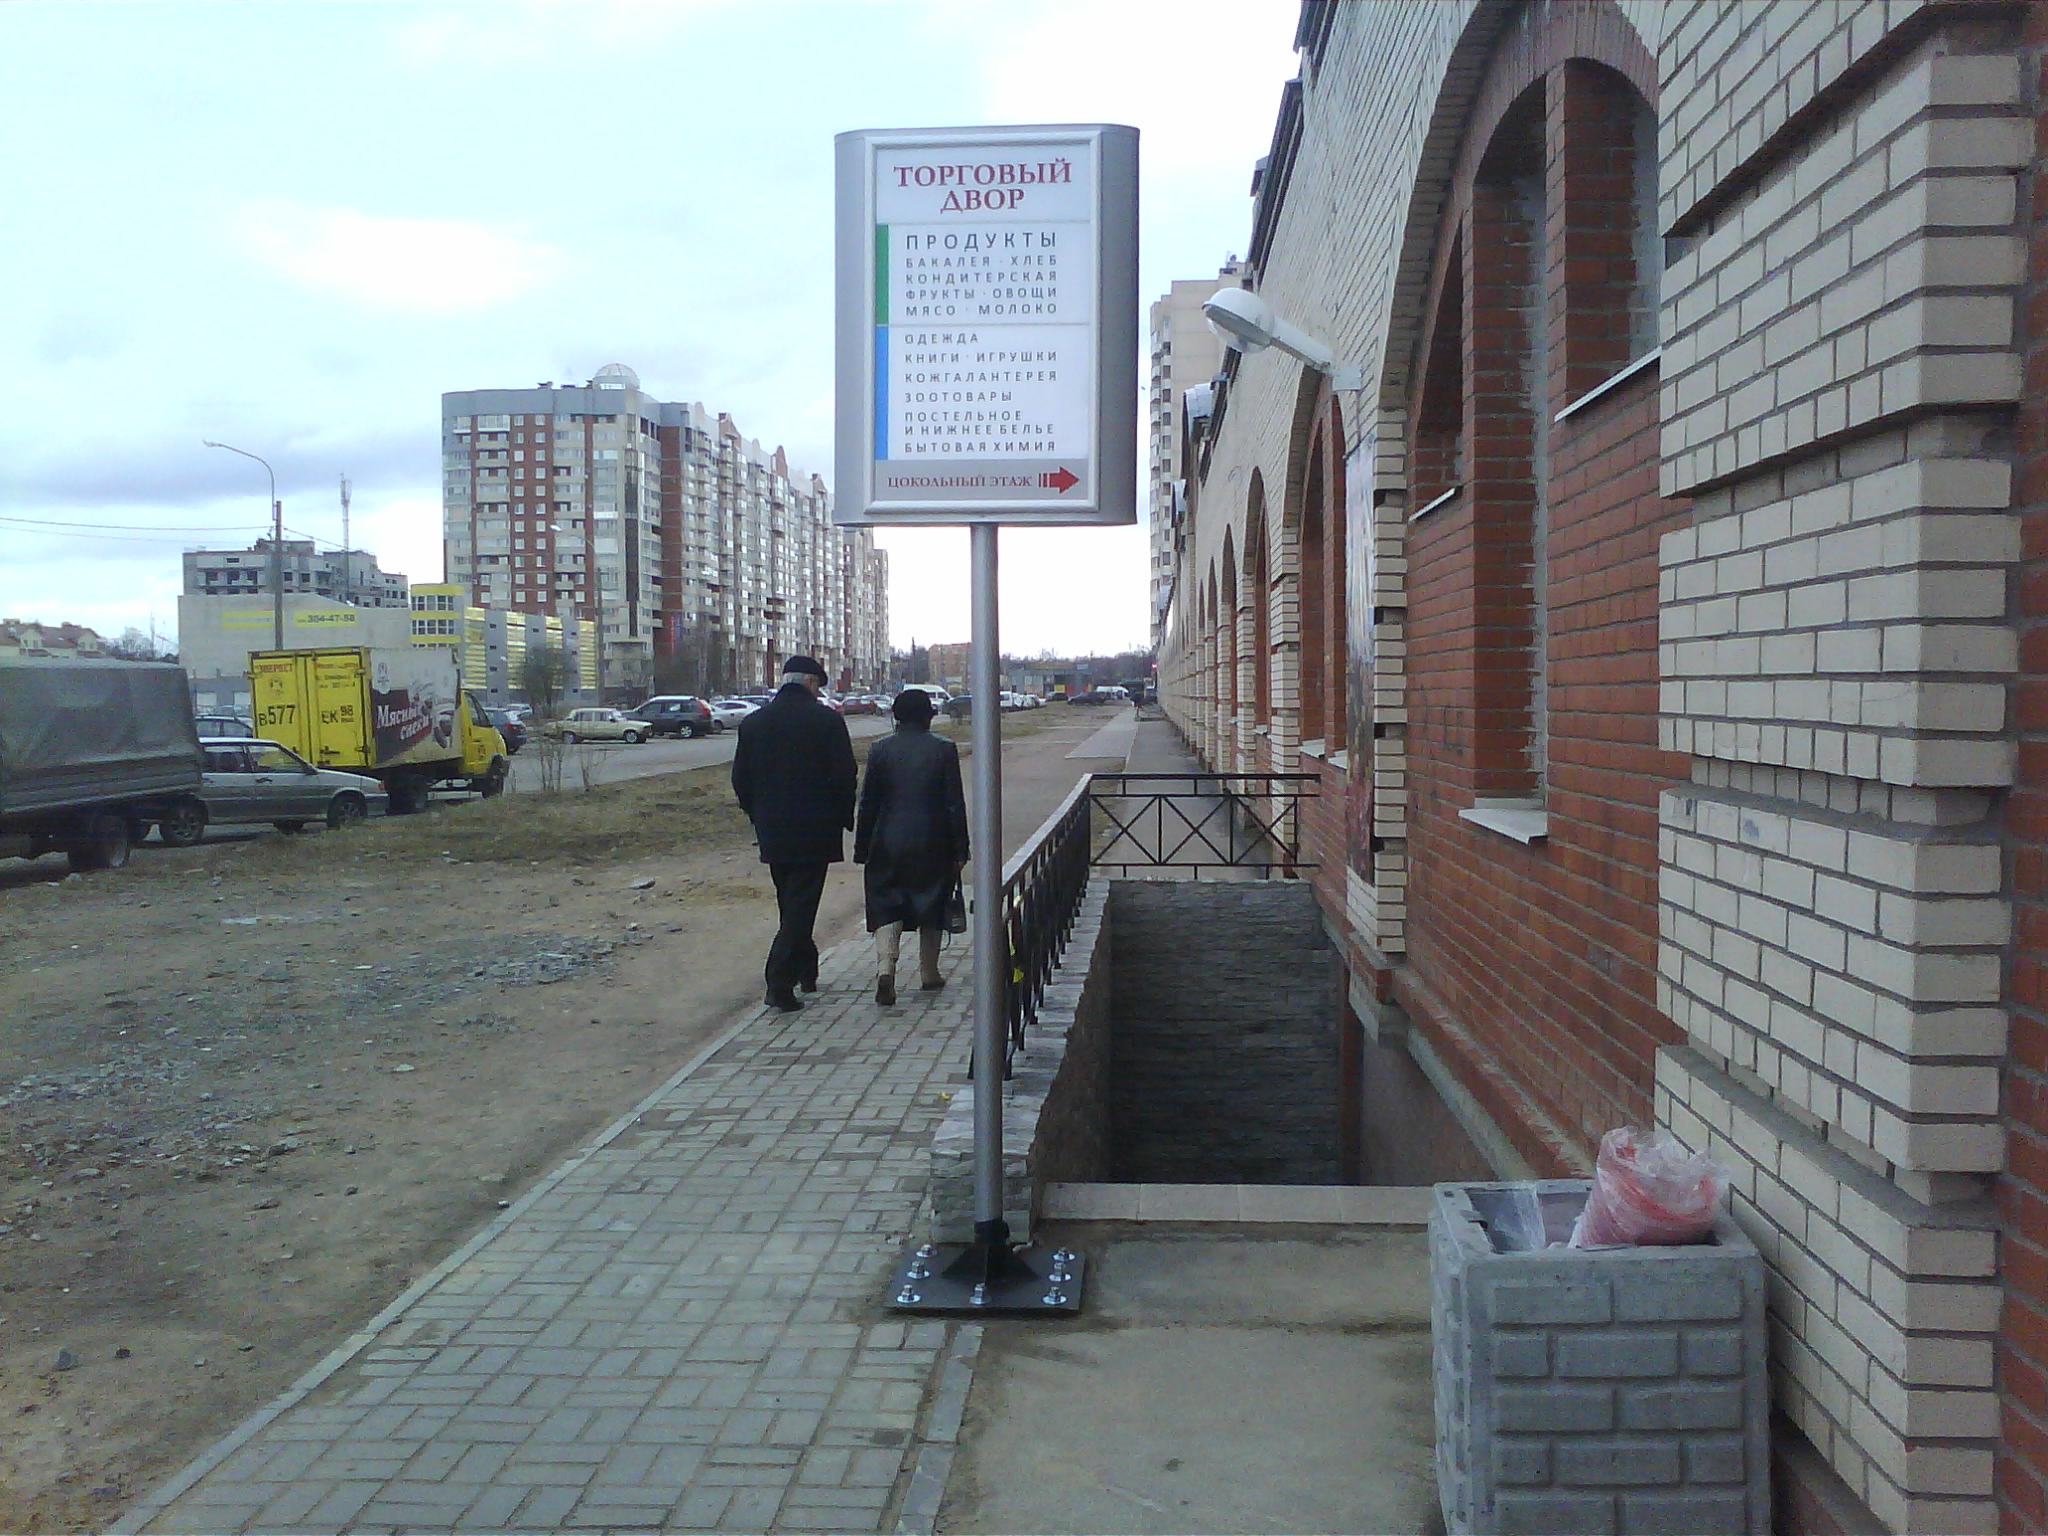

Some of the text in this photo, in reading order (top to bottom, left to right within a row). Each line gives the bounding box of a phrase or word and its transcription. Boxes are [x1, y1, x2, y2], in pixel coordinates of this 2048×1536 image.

[893, 158, 1072, 187] ТОРГОВЫЙ
[940, 189, 1025, 214] ДВОР
[906, 232, 1056, 252] ПРОДУКТЫ
[905, 254, 1057, 268] БАКАЛЕЯ ХЛЕБ
[905, 271, 1057, 285] КОНДИТЕРСКАЯ
[905, 287, 1057, 300] ФРУКТЫ ОВОЩИ
[905, 303, 1057, 317] МЯСО МОЛОКО
[904, 333, 979, 345] ОДЕЖДА
[905, 351, 1057, 364] КНИГИ ИГРУШКИ
[904, 371, 1057, 383] КОЖГАЛАНТЕРЕЯ
[904, 391, 1012, 403] ЗООТОВАРЫ
[904, 411, 1022, 422] ПОСТЕЛЬНОЕ
[904, 424, 1054, 435] И НИЖНЕЕ БЕЛЬЕ
[904, 441, 1056, 453] БЫТОВАЯ ХИМИЯ
[887, 475, 1033, 488] ЦОКОЛЬНЫЙ ЭТАЖ
